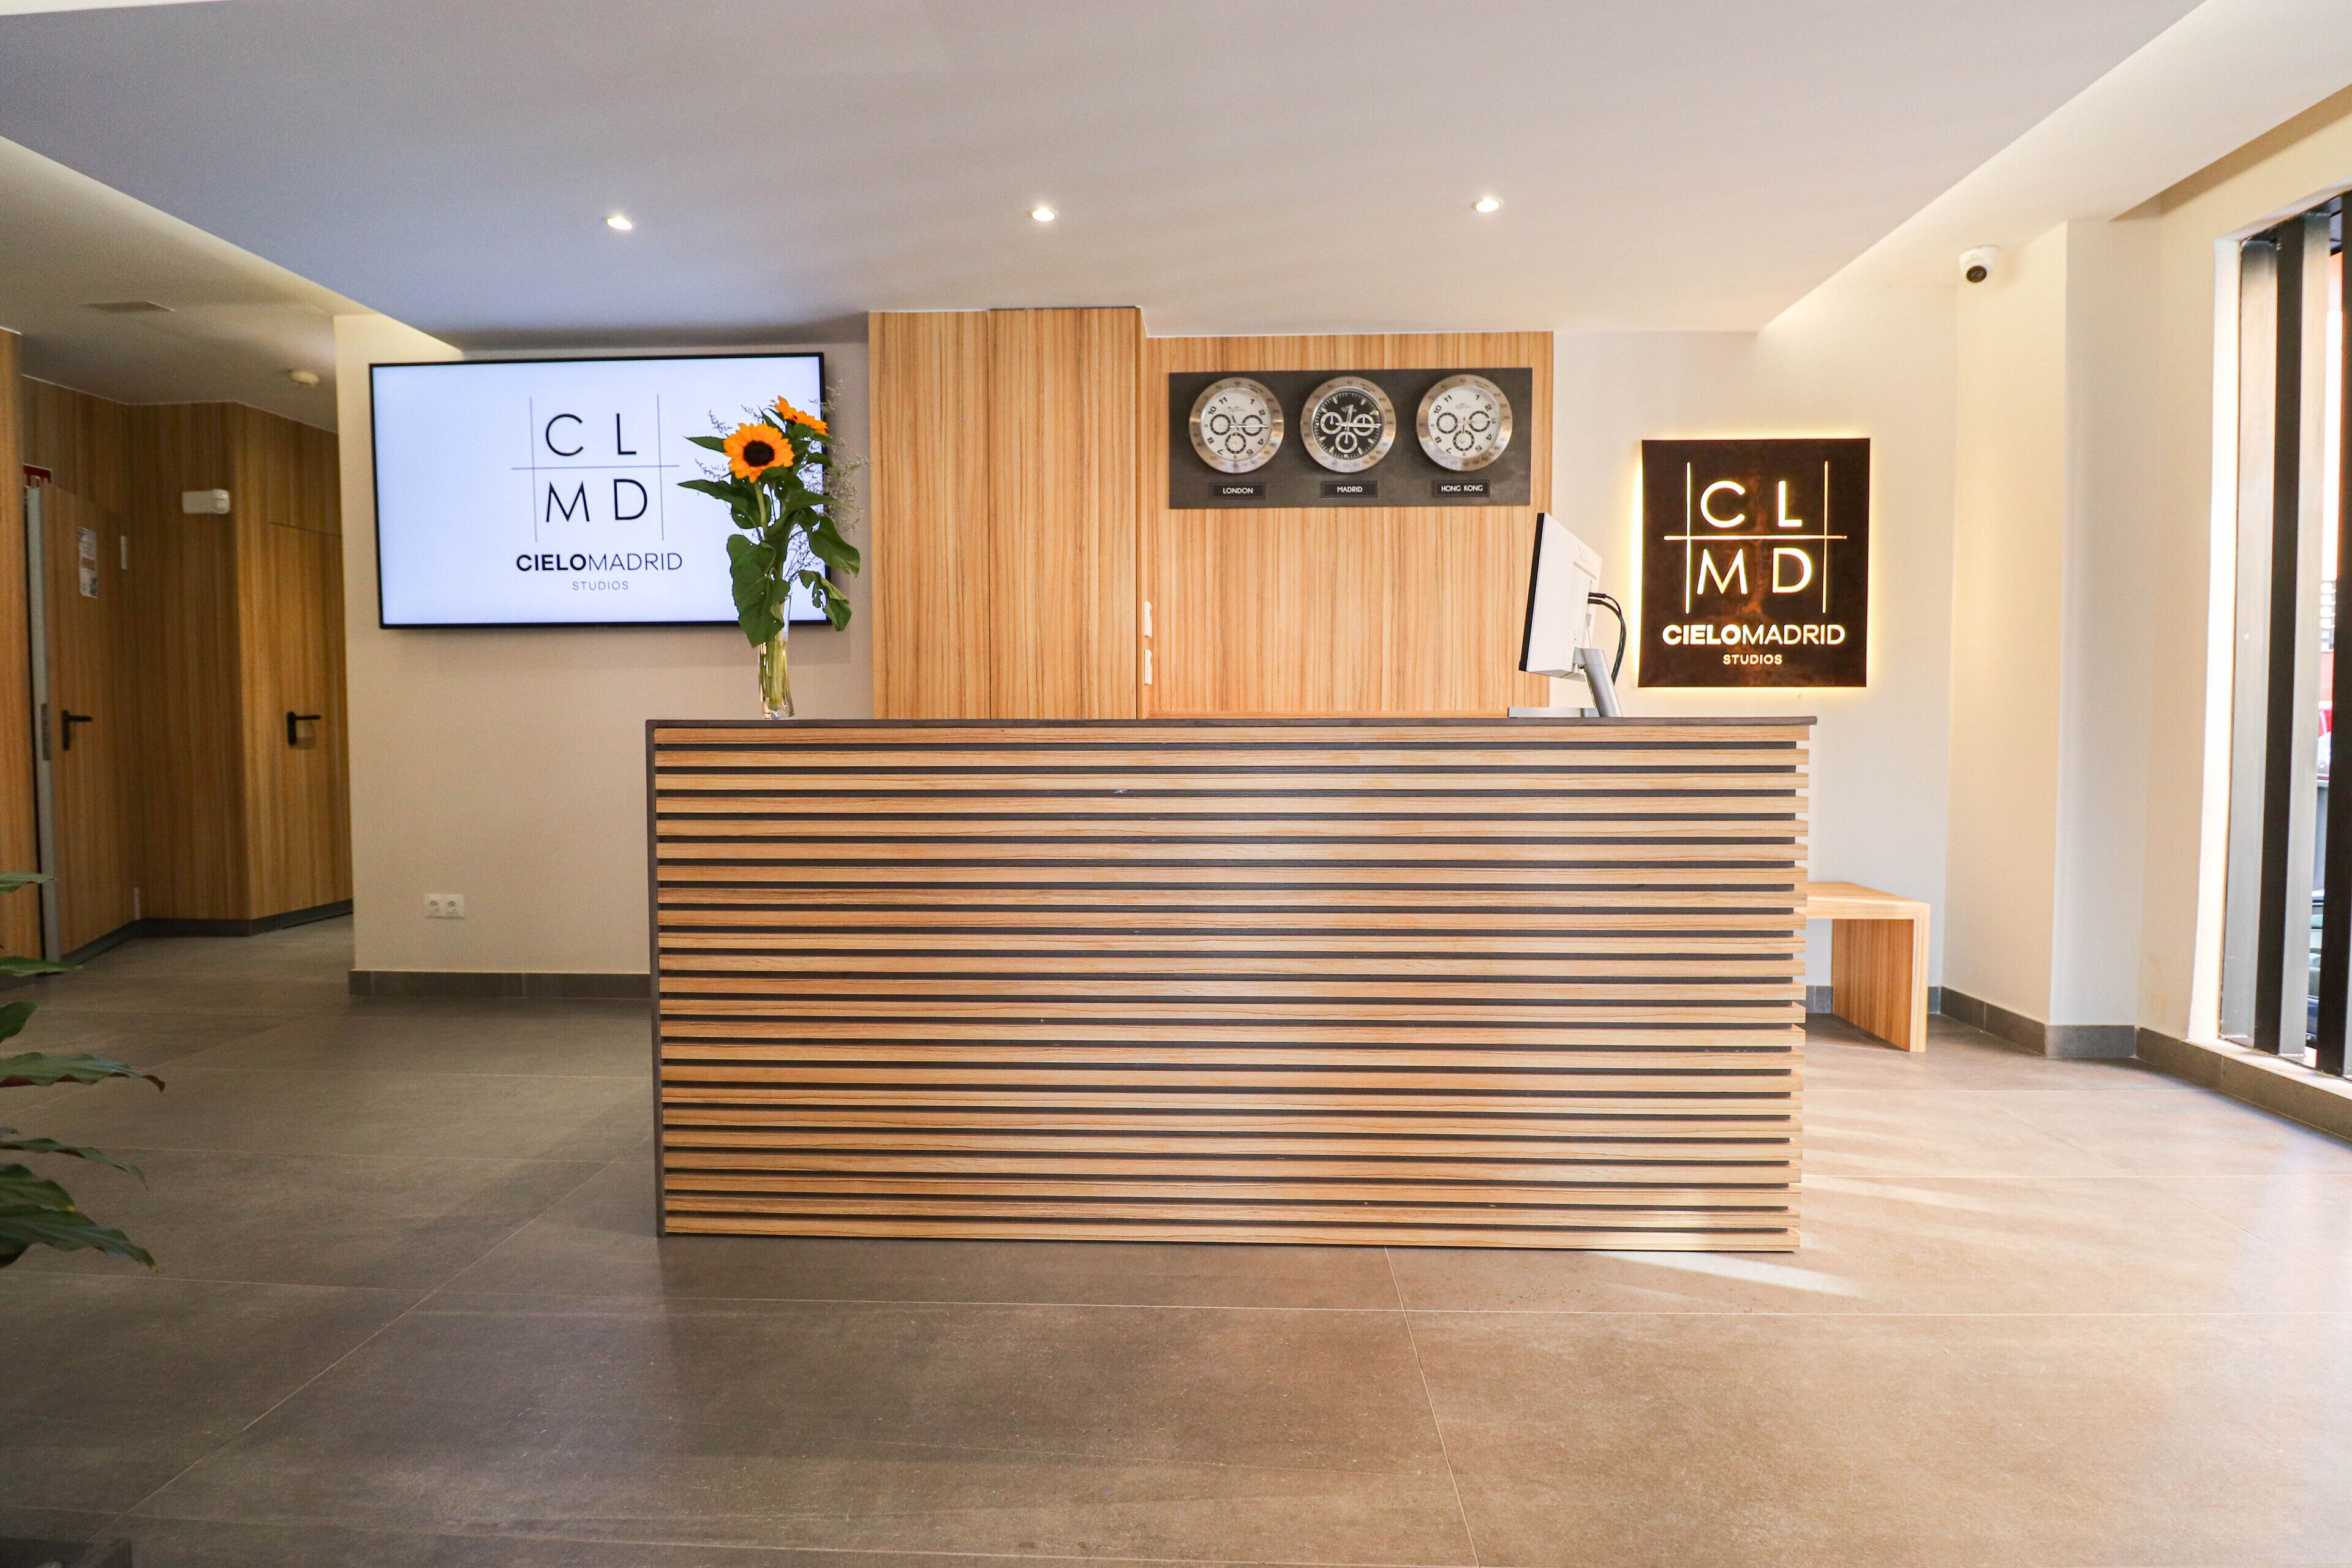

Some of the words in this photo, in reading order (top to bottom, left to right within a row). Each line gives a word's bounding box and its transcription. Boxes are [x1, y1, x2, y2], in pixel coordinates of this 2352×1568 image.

[545, 413, 584, 457] C
[616, 413, 637, 455] L
[546, 481, 590, 522] M
[613, 478, 647, 521] D
[1700, 480, 1746, 529] C
[1777, 480, 1803, 528] L
[516, 552, 683, 572] CIELOMADRID
[1697, 548, 1748, 595] M
[1772, 547, 1813, 594] D
[572, 581, 629, 591] STUDIOS
[1662, 624, 1846, 646] CIELOMADRID
[1722, 654, 1783, 665] STUDIOS
